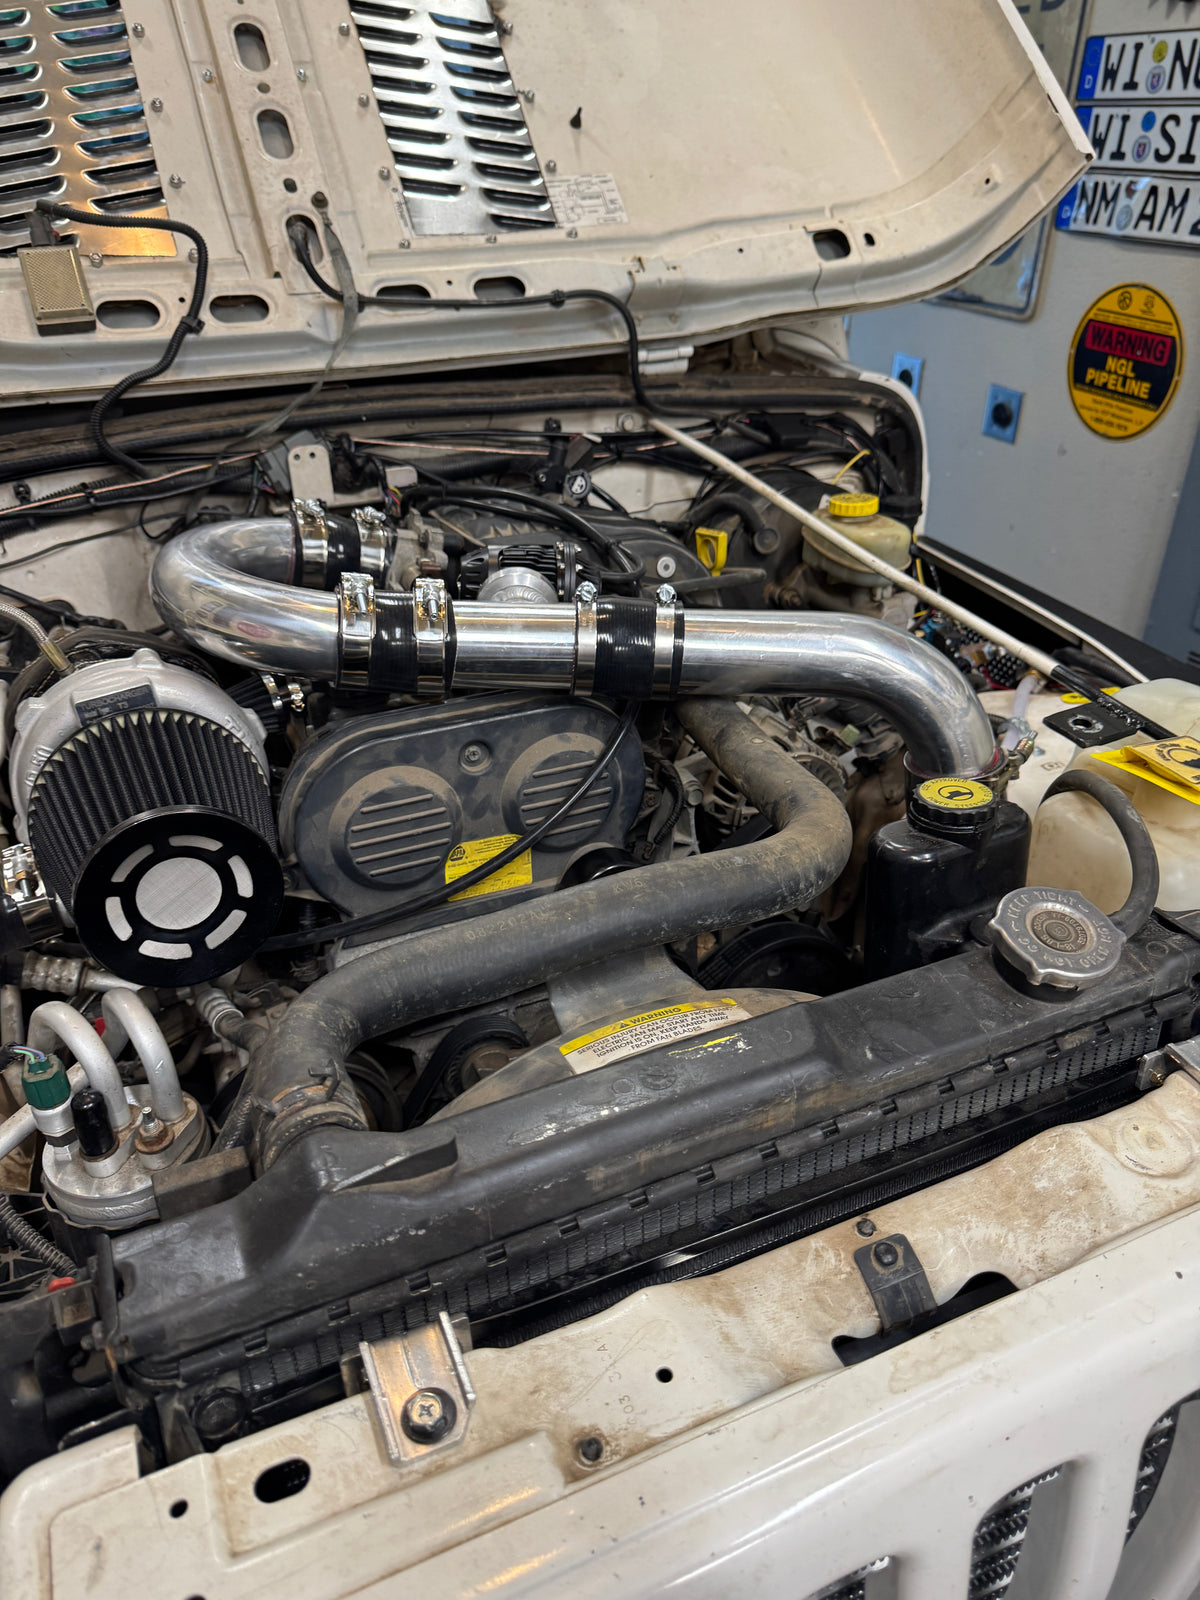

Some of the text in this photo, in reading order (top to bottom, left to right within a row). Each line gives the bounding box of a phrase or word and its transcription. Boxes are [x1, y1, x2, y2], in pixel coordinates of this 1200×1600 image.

[1084, 38, 1200, 91] D WI N
[1091, 113, 1200, 163] WI SI
[1073, 181, 1121, 227] NM
[1133, 185, 1190, 234] AM
[1091, 324, 1167, 363] WARNING
[1085, 367, 1151, 399] PIPELINE
[1105, 355, 1136, 377] NGL
[80, 687, 149, 711] TURBOCHARGER
[1033, 890, 1077, 906] TIGHT
[577, 1039, 610, 1054] SERIOUS
[610, 1027, 637, 1040] INJURY
[640, 1021, 658, 1030] CAN
[660, 1013, 690, 1023] OCCUR
[690, 1009, 710, 1017] FROM
[630, 1007, 681, 1024] WARNING
[592, 1036, 629, 1053] ELECTRIC
[630, 1030, 646, 1038] FAN
[647, 1024, 665, 1033] MAY
[666, 1018, 689, 1027] START
[597, 1040, 634, 1057] IGNITION
[660, 1025, 678, 1034] KEEP
[680, 1019, 708, 1029] HANDS
[709, 1015, 729, 1023] AWAY
[631, 1025, 705, 1050] FROM FAN BLADES.
